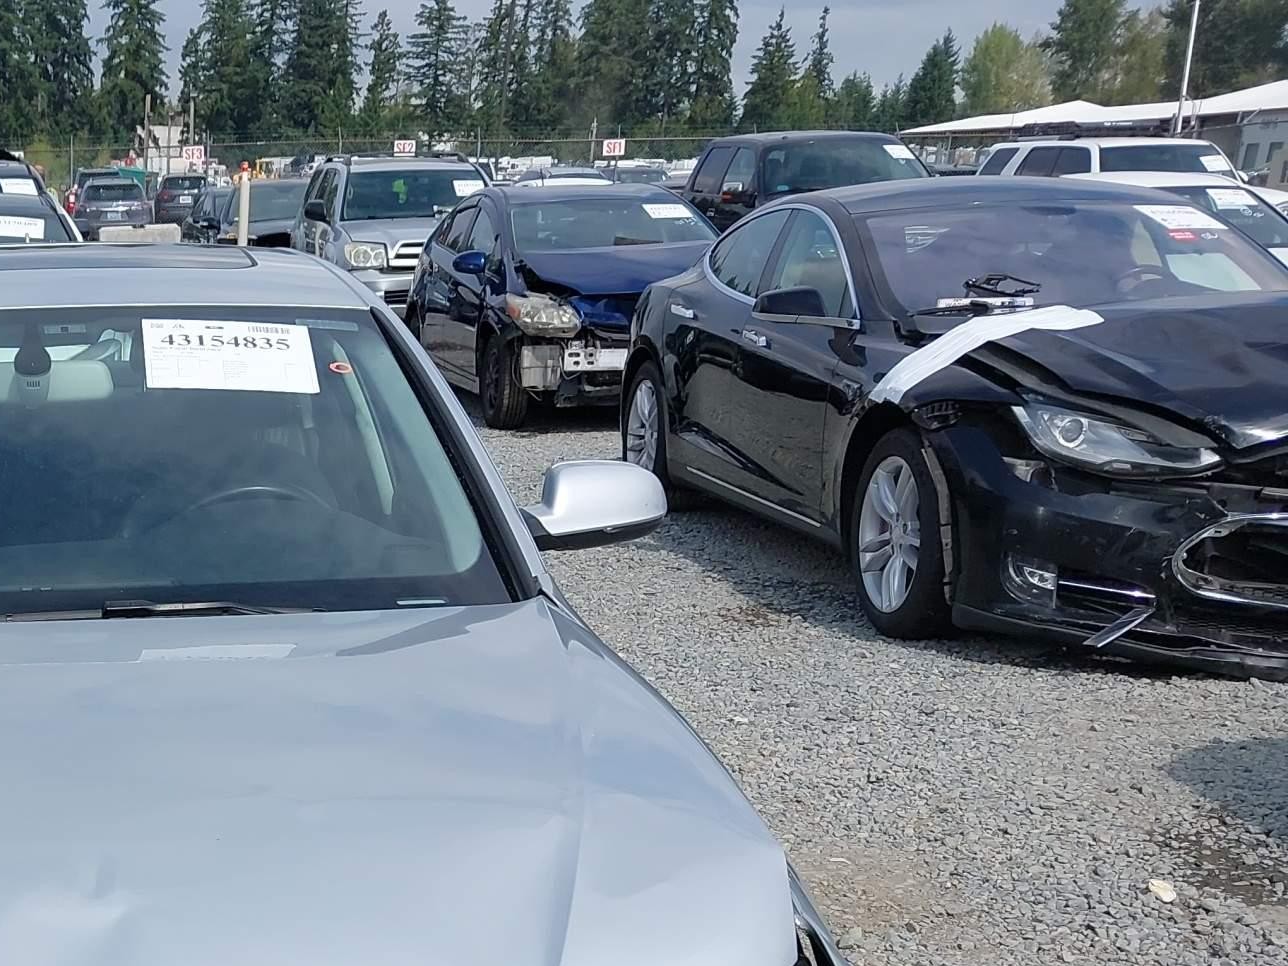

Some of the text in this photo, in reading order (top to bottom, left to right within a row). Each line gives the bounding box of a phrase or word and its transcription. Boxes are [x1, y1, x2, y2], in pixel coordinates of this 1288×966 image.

[396, 142, 413, 153] SF2
[606, 141, 622, 153] SF1
[185, 148, 202, 160] SF3
[161, 333, 290, 350] 43154835
